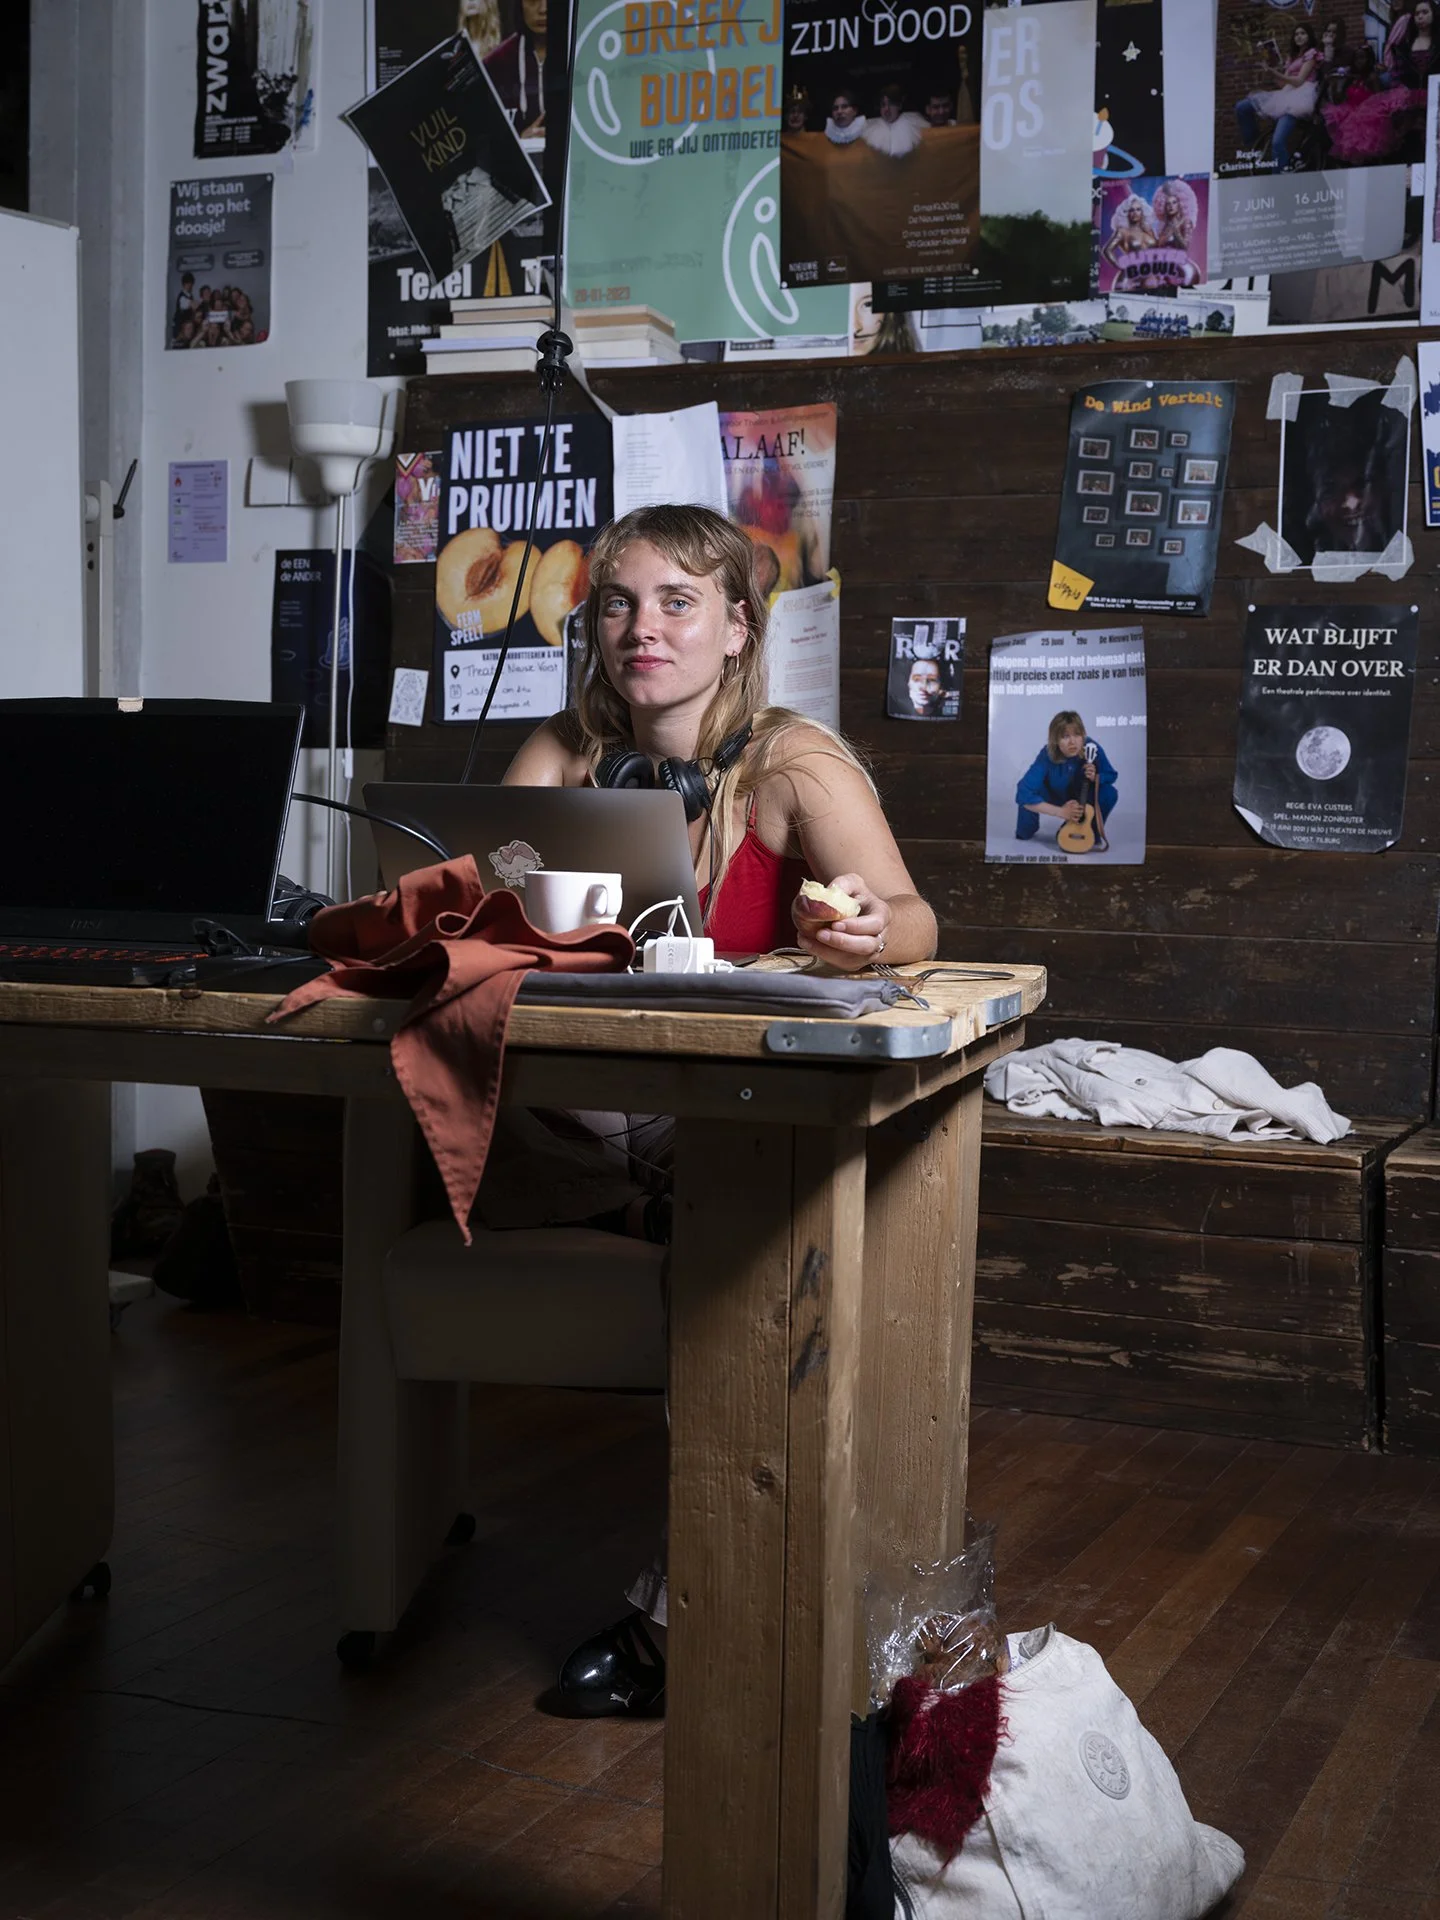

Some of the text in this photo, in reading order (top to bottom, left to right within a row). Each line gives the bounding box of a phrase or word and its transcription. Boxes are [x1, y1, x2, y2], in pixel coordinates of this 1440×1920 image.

[790, 4, 972, 56] ZIJN DOOD
[640, 64, 781, 129] BUBBEL
[410, 106, 458, 149] VUIL
[422, 127, 467, 173] KIND
[630, 140, 654, 159] WIE
[657, 137, 676, 157] GA
[678, 134, 700, 155] JIJ
[177, 182, 245, 200] Wij staan
[1295, 188, 1344, 205] 16 JUNI
[175, 198, 252, 218] niet op het
[1232, 196, 1275, 213] 7 JUNI
[175, 218, 227, 238] doosje!
[1084, 391, 1223, 414] De Wind Vertelt
[450, 423, 573, 480] NIET TE
[447, 477, 597, 535] PRUIMEN
[280, 558, 292, 569] de
[280, 570, 322, 582] de ANDER
[457, 609, 481, 629] FERM
[450, 622, 484, 647] SPEELT
[1040, 637, 1050, 646] 25
[1050, 637, 1065, 648] juni
[1099, 635, 1108, 645] De
[1109, 634, 1130, 644] Nieuwe
[1264, 627, 1398, 651] WAT BLIJFT
[992, 651, 1142, 669] Volgens mij gaat het helemaal niet
[1252, 658, 1406, 679] ER DAN OVER
[1012, 669, 1049, 683] precies
[1050, 669, 1075, 681] exact
[1076, 667, 1100, 680] zoals
[1101, 666, 1112, 681] je
[1112, 666, 1128, 679] van
[1006, 683, 1026, 695] had
[1027, 683, 1064, 697] gedacht
[1262, 686, 1275, 695] Een
[1276, 686, 1304, 696] theatrale
[1305, 687, 1346, 698] performance
[1117, 715, 1129, 728] de
[1307, 803, 1323, 811] EVA
[1323, 803, 1354, 812] CUSTERS
[1291, 814, 1322, 823] MANON
[1277, 824, 1292, 832] JUNI
[1329, 827, 1356, 836] THEATER
[1367, 829, 1393, 837] NIEUWE
[1315, 836, 1341, 845] TILBURG
[1026, 854, 1038, 863] van
[1039, 854, 1051, 863] den
